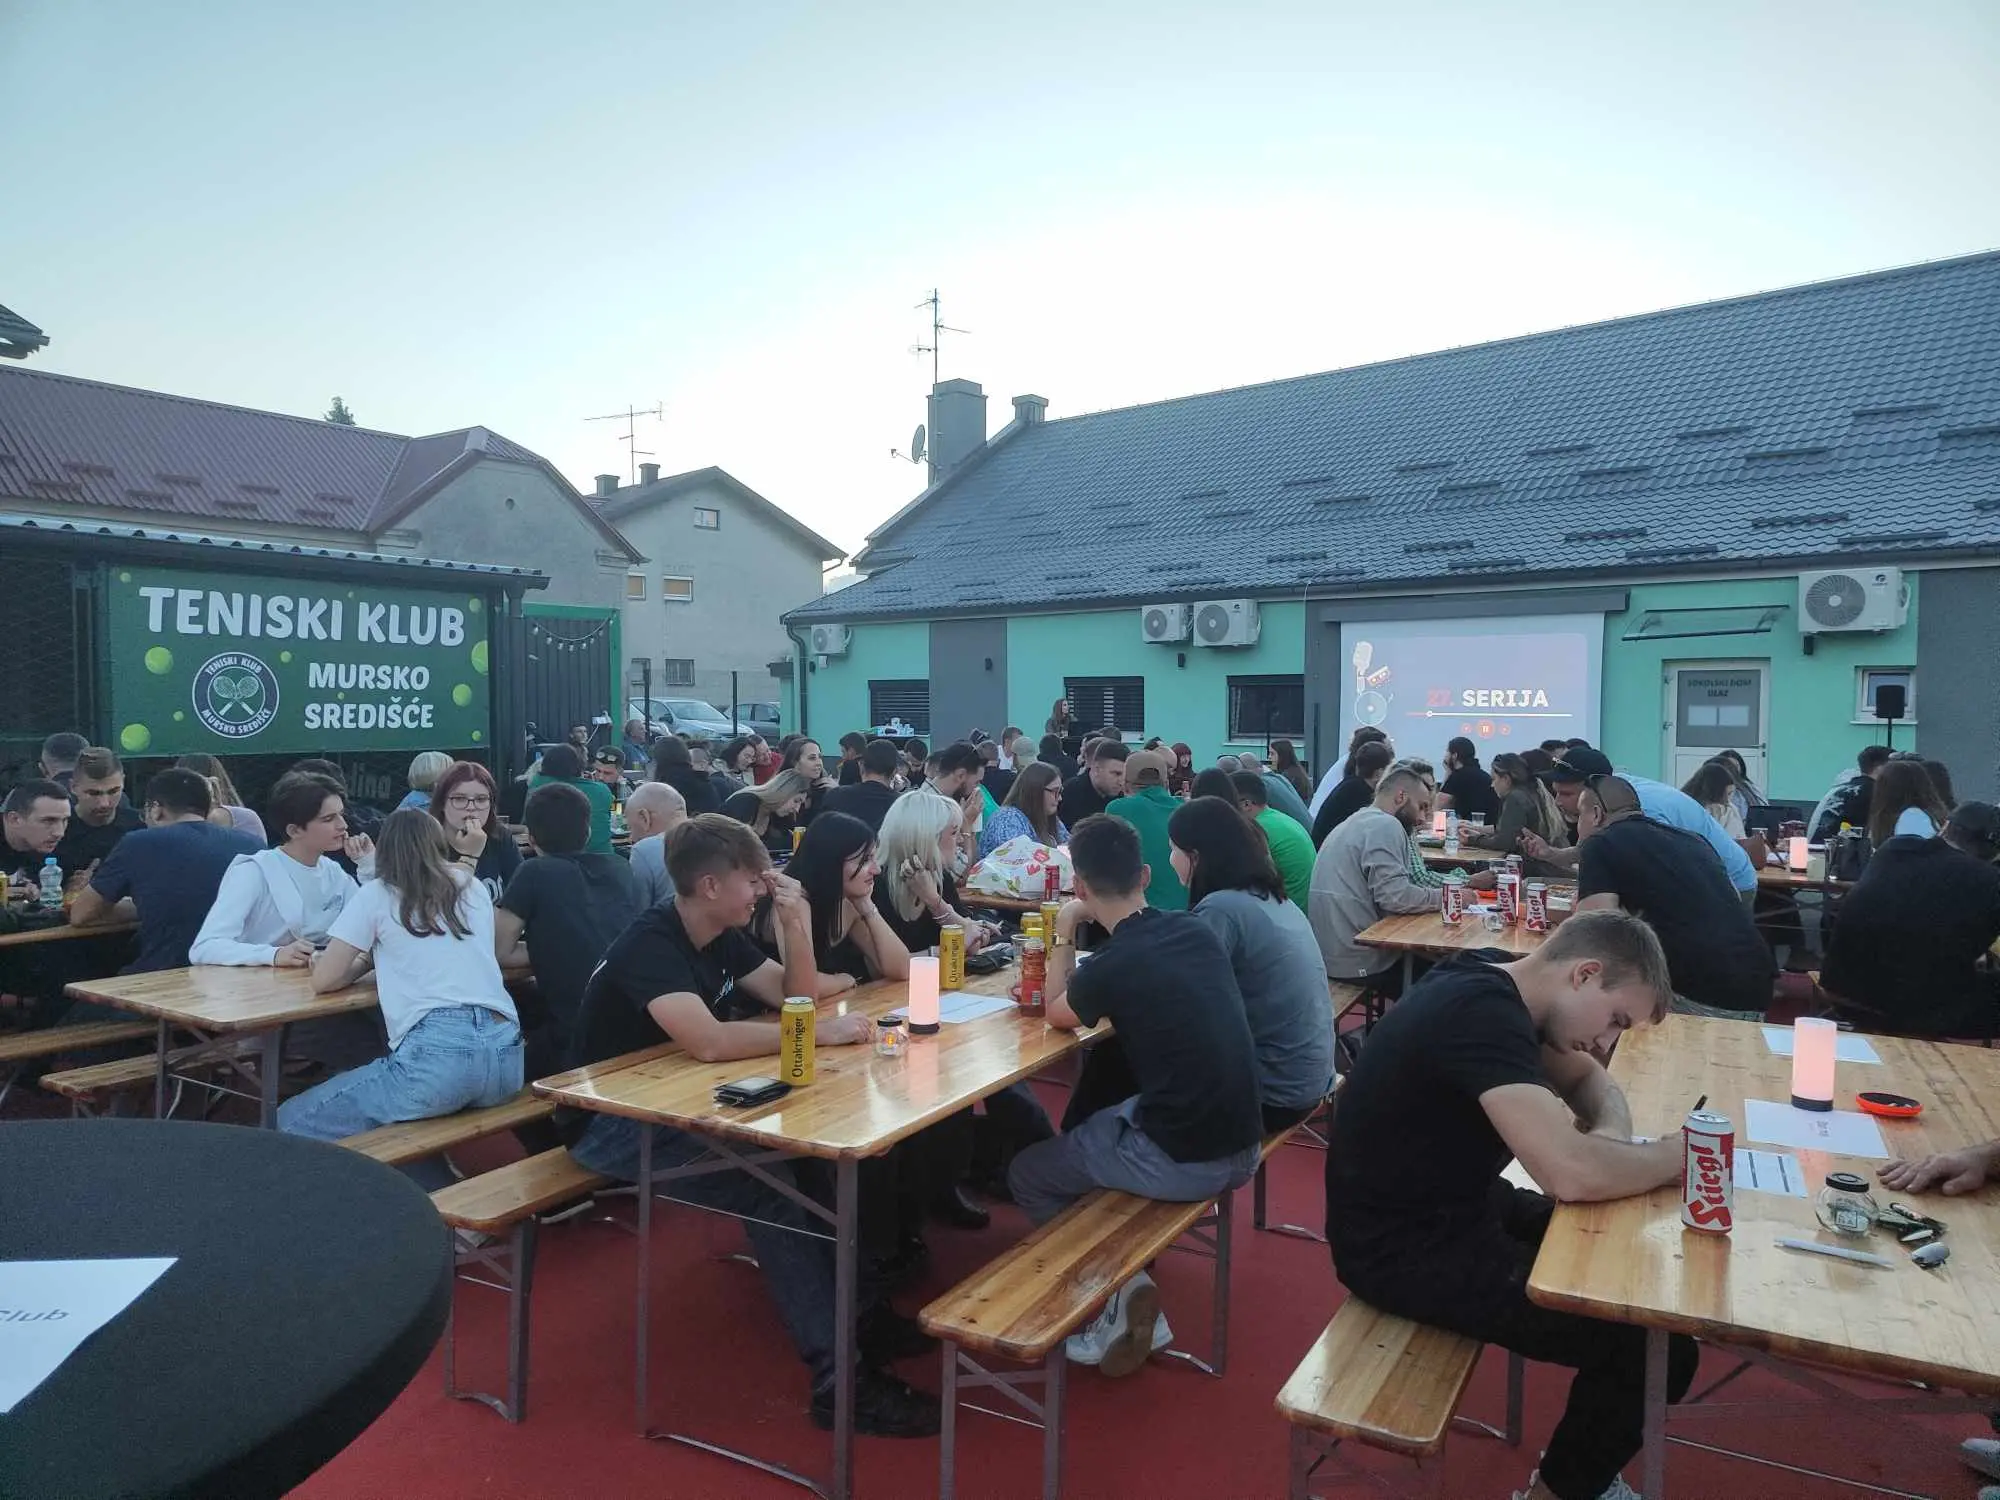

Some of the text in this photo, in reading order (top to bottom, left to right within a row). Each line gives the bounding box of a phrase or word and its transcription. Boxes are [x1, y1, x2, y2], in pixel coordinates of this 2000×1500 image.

[139, 586, 465, 647] TENISKI KLUB
[205, 656, 263, 675] TENISKI KLUB
[308, 662, 430, 691] MURSKO
[303, 696, 434, 730] SREDIŠĆE
[1461, 688, 1549, 707] SERIJA
[201, 709, 236, 734] MURSKO
[791, 1017, 806, 1078] Ottakringer
[1687, 1143, 1733, 1228] Stiegl
